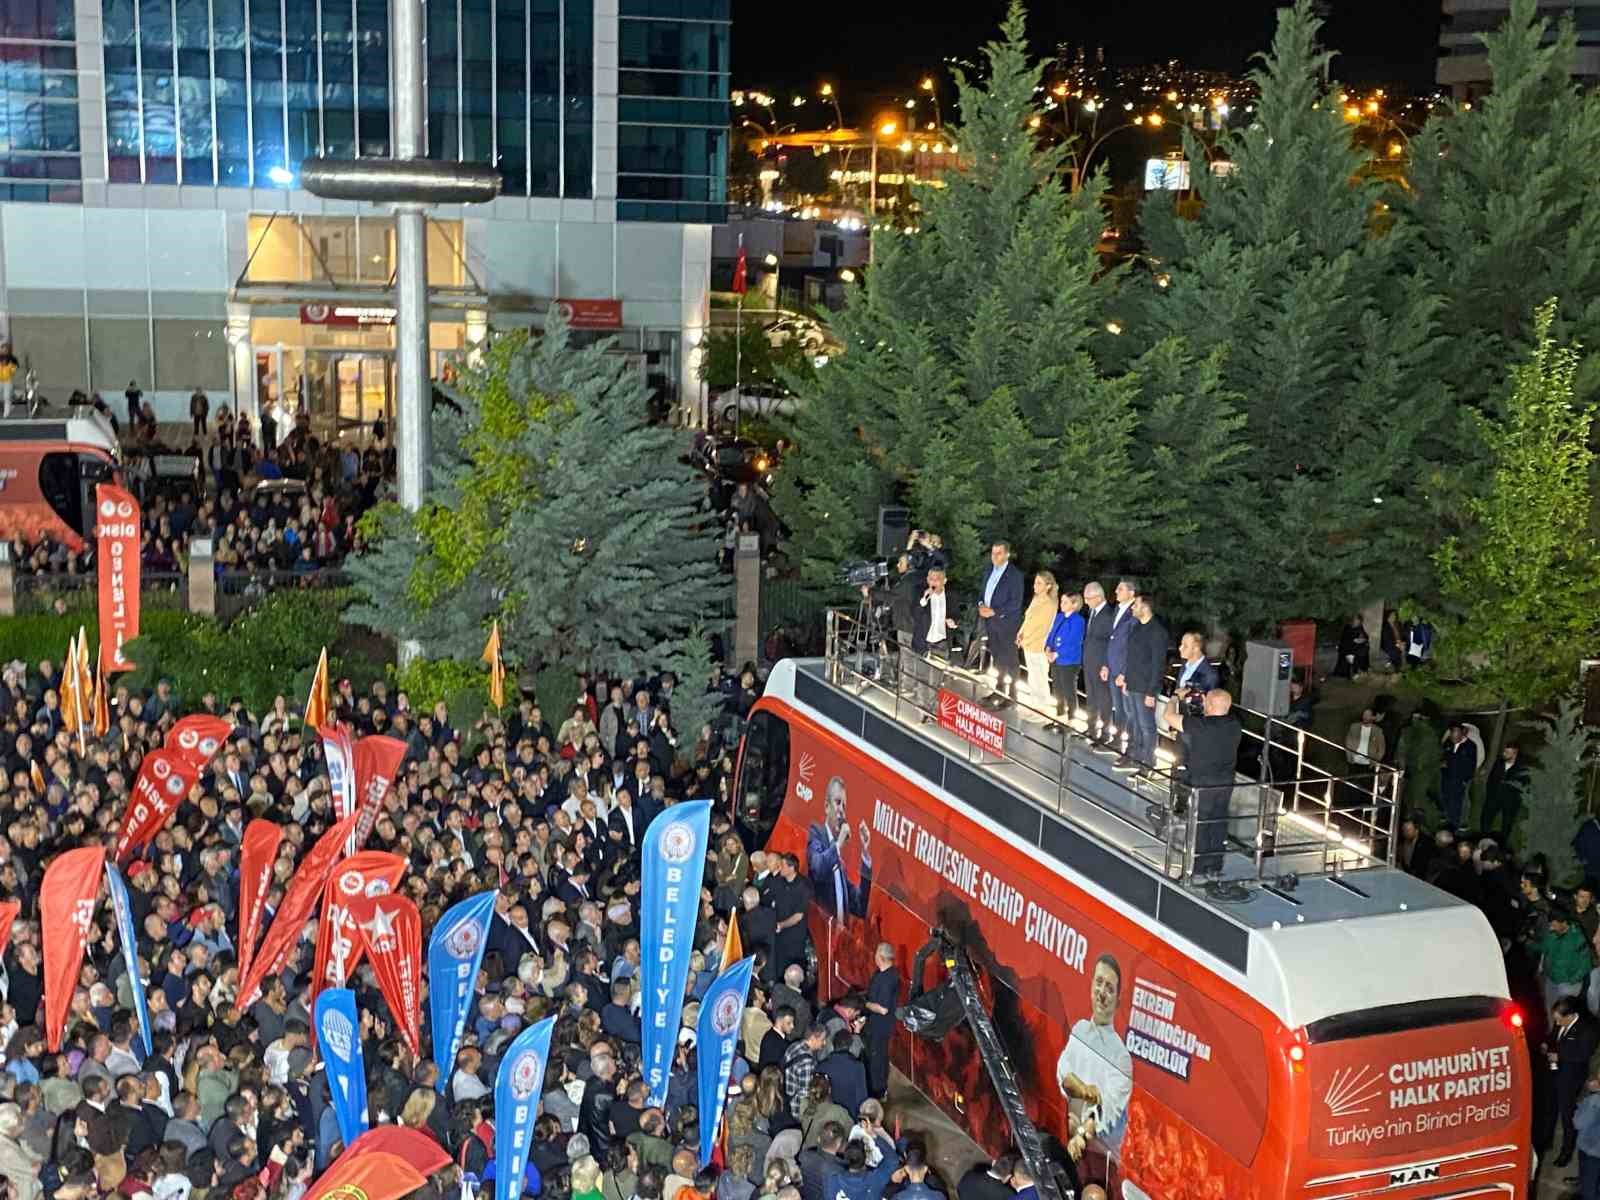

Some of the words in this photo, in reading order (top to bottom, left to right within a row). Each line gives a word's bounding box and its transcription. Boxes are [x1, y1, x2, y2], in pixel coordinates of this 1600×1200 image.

[955, 714, 975, 737] HALK
[873, 799, 914, 853] MİLLET
[914, 826, 980, 899] İRADESİNE
[980, 871, 1024, 926] SAHİP
[1024, 901, 1088, 975] ÇIKIYOR
[1132, 986, 1175, 1021] EKREM
[1388, 1046, 1510, 1084] CUMHURİYET
[1390, 1083, 1440, 1109] HALK
[1444, 1066, 1511, 1100] PARTİSİ
[1326, 1118, 1412, 1146] Türkiye'nin
[1416, 1107, 1462, 1133] Birinci
[1465, 1098, 1511, 1123] Partisi
[1389, 1166, 1440, 1185] MAN
